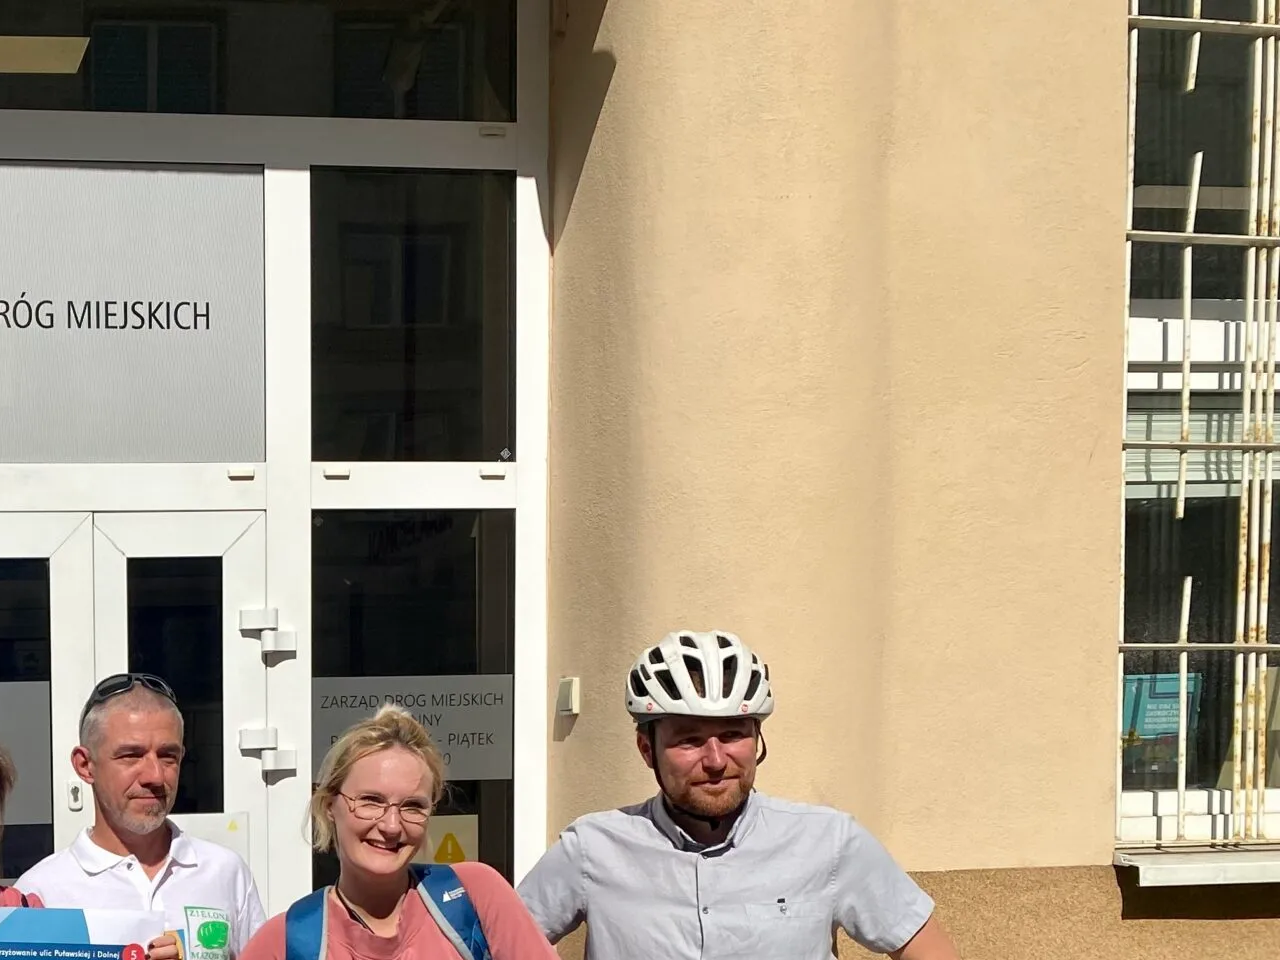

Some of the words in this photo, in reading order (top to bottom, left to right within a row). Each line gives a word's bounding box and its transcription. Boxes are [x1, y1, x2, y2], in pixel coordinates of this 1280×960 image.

[67, 301, 211, 330] MIEJSKICH
[321, 695, 379, 711] ZARZĄD
[431, 692, 504, 707] MIEJSKICH
[448, 732, 494, 748] PIĄTEK
[39, 949, 52, 957] ulic
[54, 949, 91, 959] Puławskiej
[97, 950, 120, 960] Dolnej
[130, 950, 137, 960] 5
